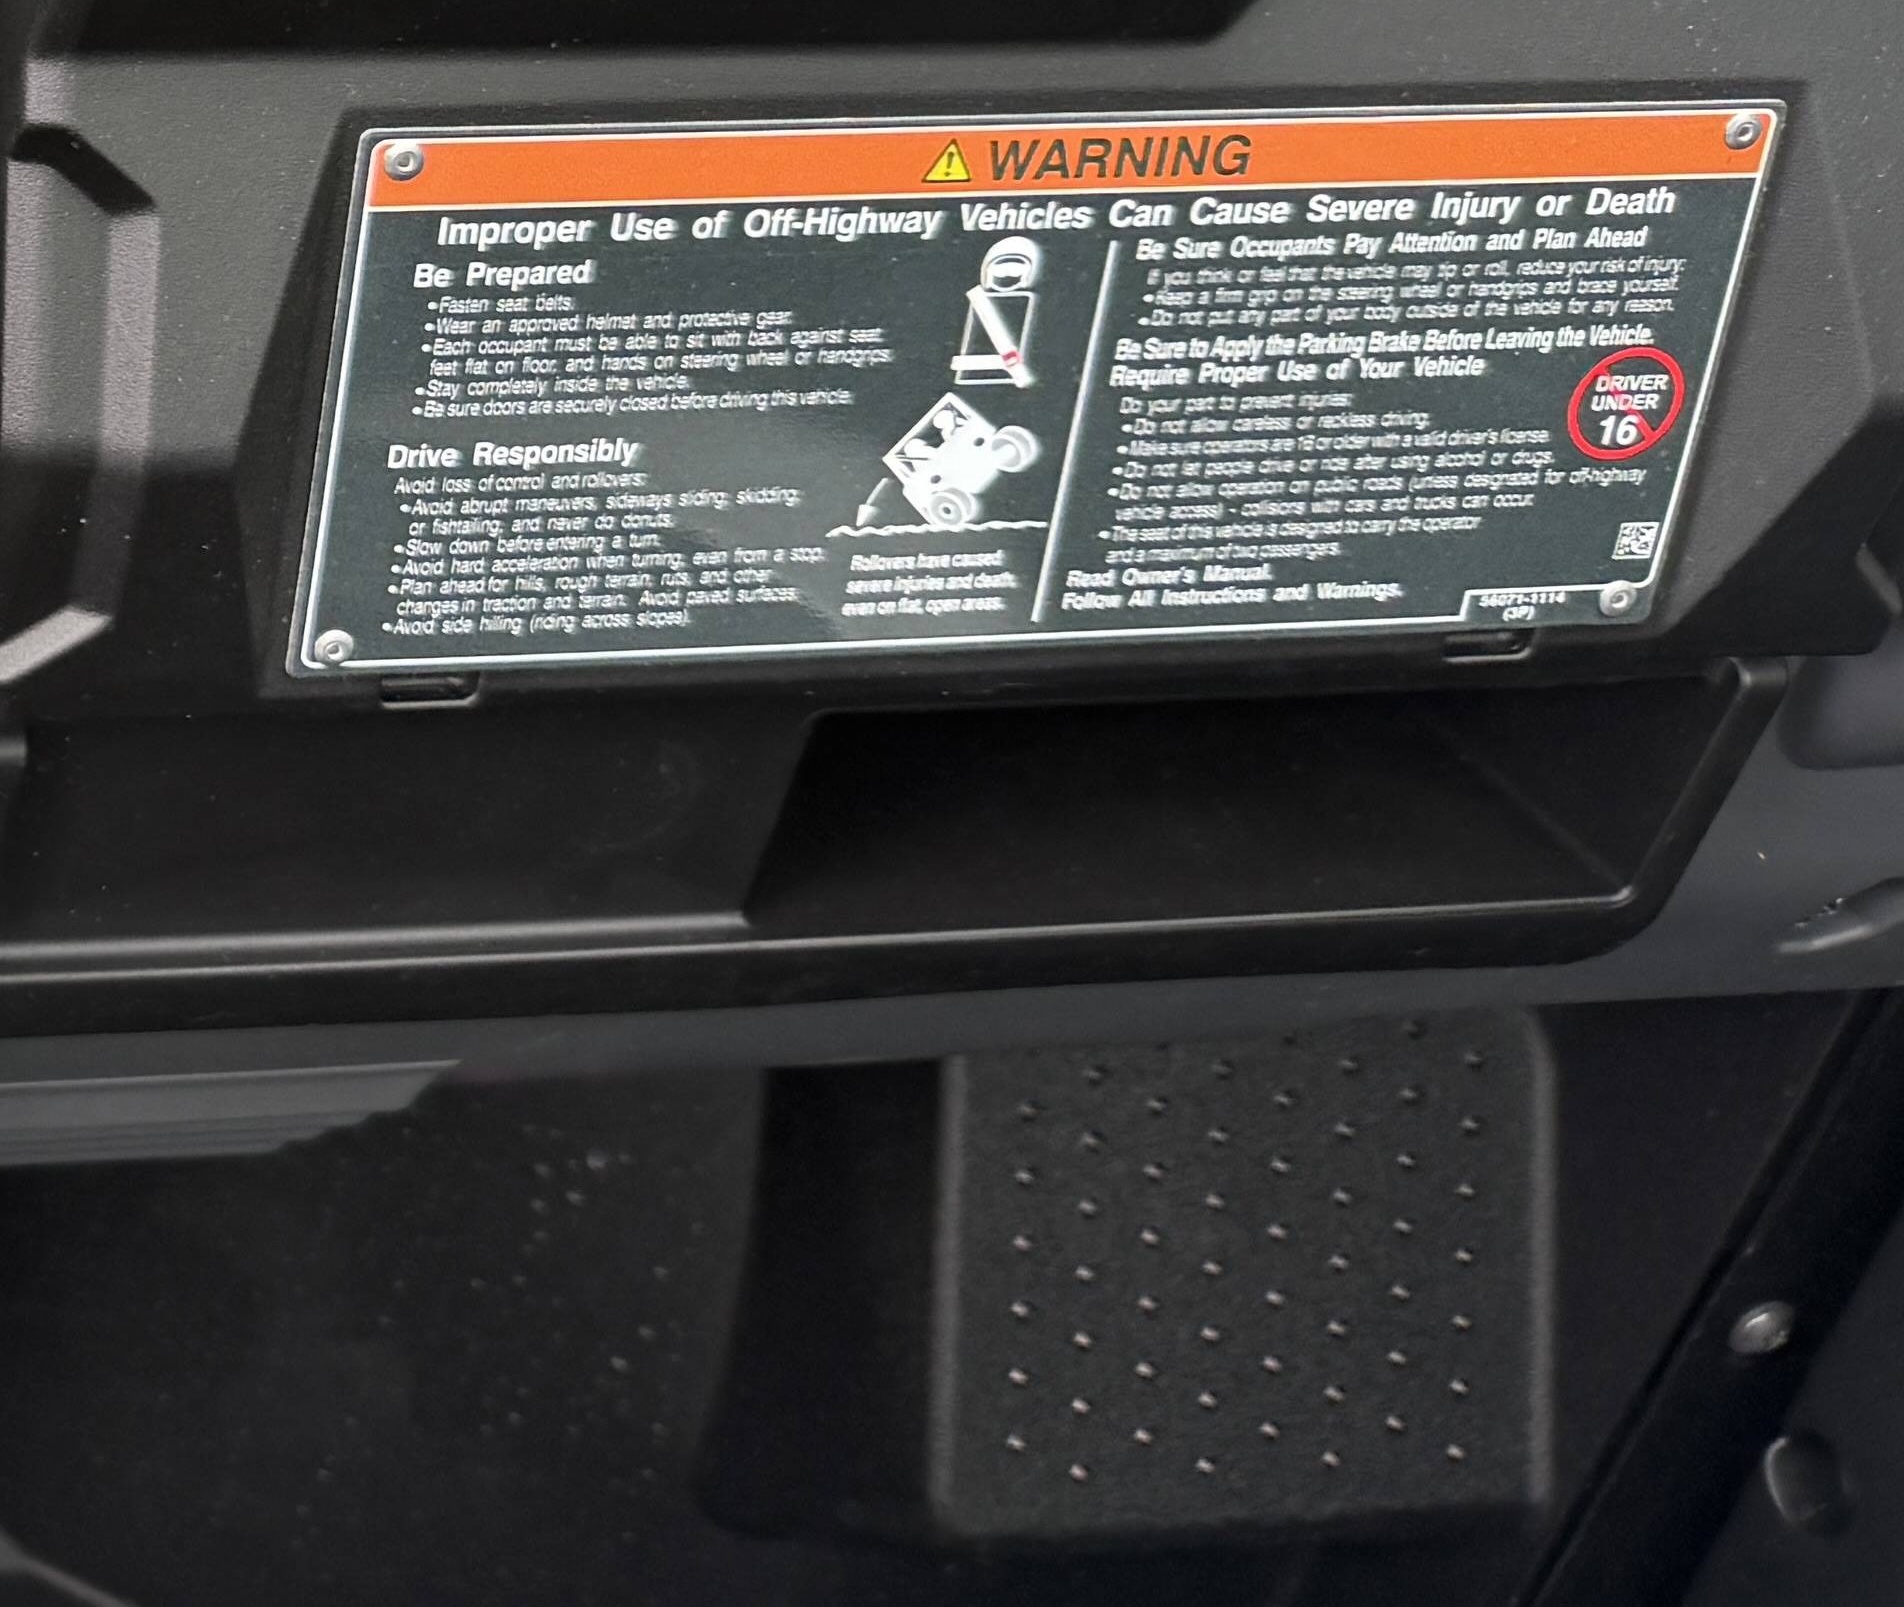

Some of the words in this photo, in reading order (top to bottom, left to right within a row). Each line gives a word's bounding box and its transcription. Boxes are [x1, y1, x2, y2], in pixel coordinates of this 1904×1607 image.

[990, 134, 1252, 181] WARNING
[437, 216, 595, 252] Improper
[610, 212, 677, 242] Use
[691, 209, 730, 239] of
[743, 206, 944, 242] Off-Highway
[960, 201, 1094, 231] Vehicles
[1108, 199, 1175, 228] Can
[1189, 196, 1293, 226] Cause
[1306, 193, 1417, 223] Severe
[1430, 191, 1522, 225] Injury
[1535, 194, 1573, 217] or
[1585, 186, 1677, 216] Death
[1135, 238, 1167, 261] Be
[1172, 236, 1223, 260] Sure
[1229, 235, 1337, 262] Occupants
[1343, 233, 1383, 260] Pay
[1387, 230, 1479, 253] Attention
[1485, 228, 1526, 251] and
[1532, 227, 1578, 250] Plan
[1583, 225, 1649, 248] Ahead
[413, 263, 454, 288] Be
[466, 258, 593, 292] Prepared
[1114, 338, 1142, 361] Be
[1142, 337, 1188, 360] Sure
[1188, 337, 1210, 358] to
[1208, 334, 1265, 361] Apply
[1264, 333, 1296, 356] the
[1297, 332, 1367, 357] Parking
[1367, 330, 1422, 353] Brake
[1422, 328, 1483, 352] Before
[1484, 326, 1555, 351] Leaving
[1555, 325, 1586, 348] the
[1589, 323, 1655, 347] Vehicle.
[1109, 363, 1191, 391] Require
[1198, 359, 1270, 388] Proper
[1277, 359, 1320, 382] Use
[1325, 356, 1357, 381] of
[1356, 356, 1406, 379] Your
[1414, 354, 1487, 377] Vehicle
[1595, 374, 1670, 393] DRIVER
[1591, 393, 1660, 412] UNDER
[1599, 414, 1640, 446] 16
[387, 443, 460, 469] Drive
[472, 437, 641, 471] Responsibly
[1065, 569, 1117, 588] Read
[1121, 566, 1197, 586] Owner's
[1202, 562, 1273, 582] Manual.
[1061, 591, 1123, 611] Follow
[1127, 589, 1157, 607] All
[1160, 586, 1267, 606] Instructions
[1272, 583, 1310, 602] and
[1316, 580, 1403, 602] Warnings.
